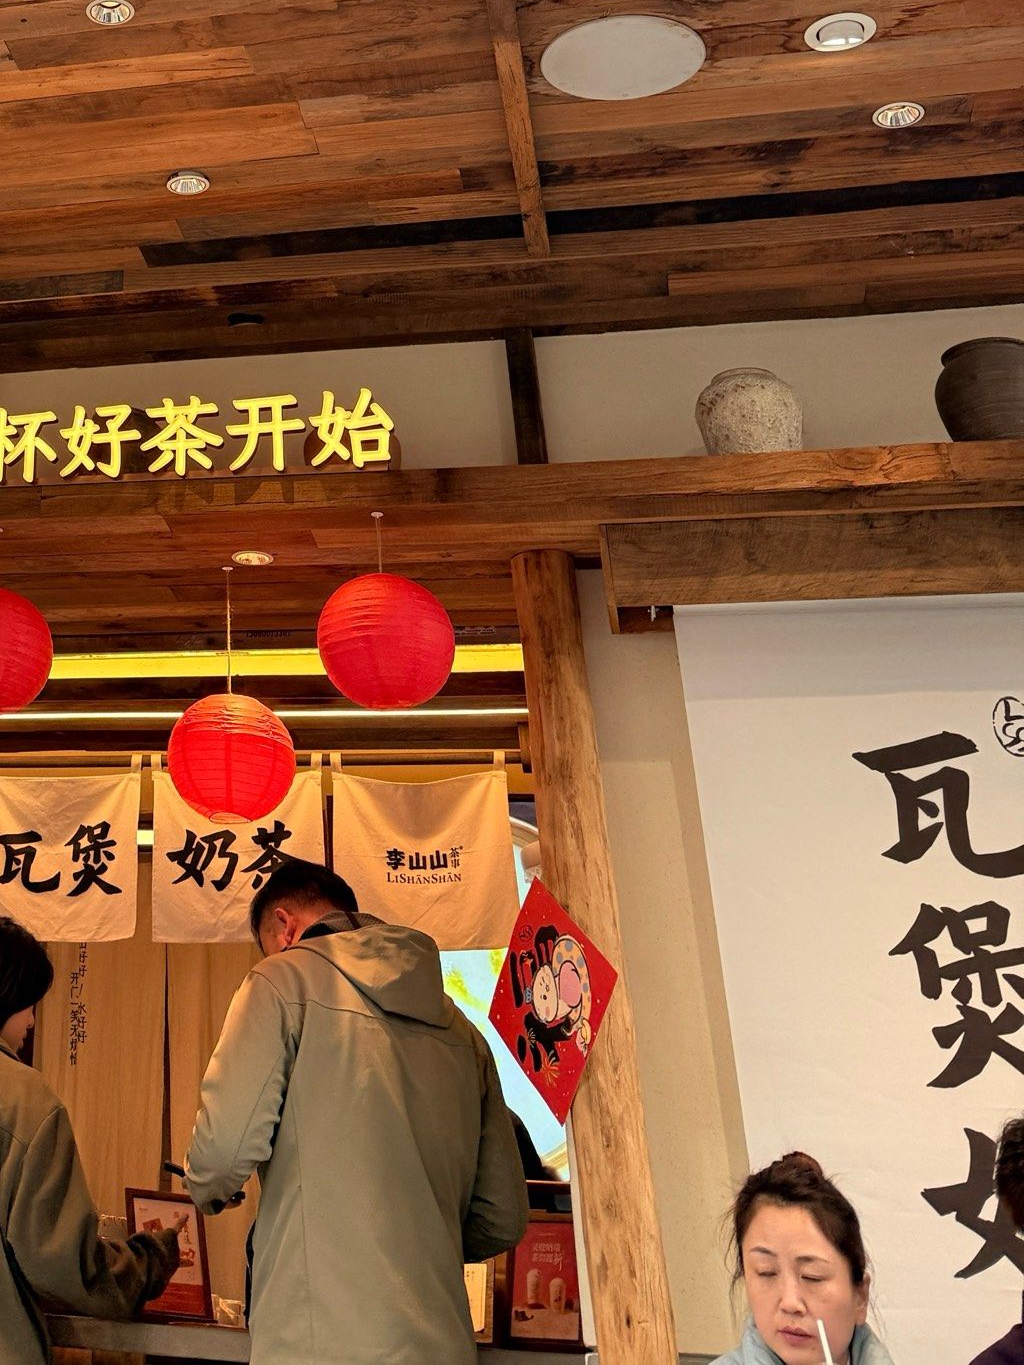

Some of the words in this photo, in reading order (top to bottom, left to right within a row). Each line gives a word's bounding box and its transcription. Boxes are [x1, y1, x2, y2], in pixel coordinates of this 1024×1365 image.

[166, 819, 293, 893] 奶茶
[386, 848, 448, 871] 李山山
